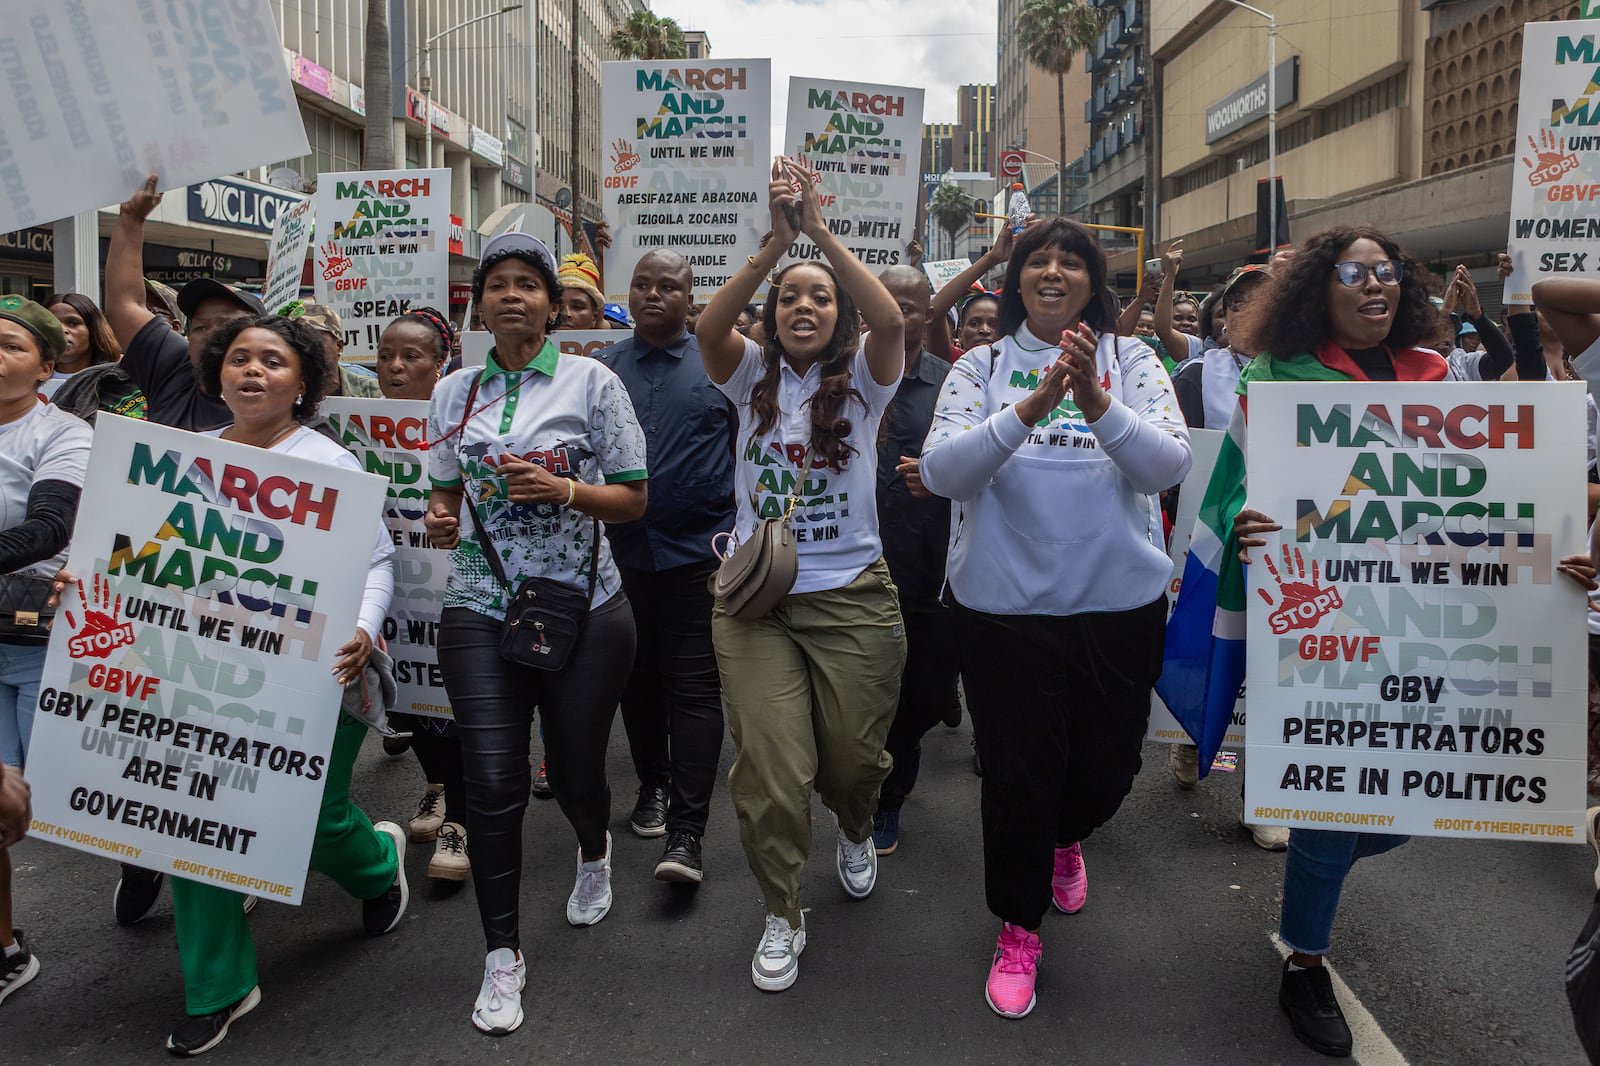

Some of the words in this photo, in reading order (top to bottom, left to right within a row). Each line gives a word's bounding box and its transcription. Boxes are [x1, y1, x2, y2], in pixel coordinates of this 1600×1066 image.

[636, 67, 747, 92] MARCH
[657, 92, 725, 115] AND
[808, 88, 905, 116] MARCH
[1207, 83, 1267, 134] WOOLWORTHS
[636, 115, 747, 140] MARCH
[824, 112, 884, 136] AND
[650, 146, 685, 159] UNTIL
[689, 145, 708, 158] WE
[712, 145, 735, 158] WIN
[804, 132, 901, 160] MARCH
[614, 154, 641, 174] STOP!
[815, 160, 846, 172] UNTIL
[850, 163, 867, 174] WE
[870, 165, 890, 176] WIN
[1530, 155, 1578, 186] STOP!
[336, 178, 431, 200] MARCH
[604, 175, 639, 189] GBVF
[1547, 185, 1600, 202] GBVF
[222, 185, 299, 230] CLICK
[352, 199, 411, 219] AND
[617, 192, 697, 205] ABESIFAZANE
[701, 191, 758, 204] ABAZONA
[819, 194, 837, 208] VF
[333, 217, 429, 240] MARCH
[637, 213, 684, 226] IZIGQILA
[688, 212, 738, 225] ZOCANSI
[858, 221, 901, 239] WITH
[1516, 218, 1600, 239] WOMEN
[345, 245, 376, 256] UNTIL
[379, 244, 394, 255] WE
[398, 243, 418, 254] WIN
[638, 234, 664, 247] IYINI
[668, 233, 737, 246] INKULULEKO
[787, 243, 821, 260] OUR
[324, 259, 352, 280] STOP!
[687, 255, 727, 266] ANDLE
[1538, 252, 1589, 272] SEX
[155, 271, 202, 281] CLICKS
[335, 278, 367, 291] GBVF
[693, 275, 734, 287] BENZI
[353, 299, 411, 318] SPEAK
[1296, 403, 1535, 449] MARCH
[1049, 434, 1068, 447] WE
[1073, 436, 1096, 449] WIN
[127, 442, 339, 531] MARCH
[755, 468, 828, 497] AND
[1340, 452, 1487, 497] AND
[751, 492, 849, 523] ARCH
[155, 500, 284, 564] AND
[487, 526, 517, 541] NTIL
[519, 524, 537, 536] WE
[542, 521, 561, 534] WIN
[812, 525, 839, 542] WIN
[1296, 499, 1535, 547] MARCH
[107, 533, 319, 623] MARCH
[1325, 559, 1400, 584] UNTIL
[1410, 561, 1450, 585] WE
[1461, 562, 1509, 587] WIN
[1271, 590, 1341, 633] STOP!
[124, 596, 190, 632] UNTIL
[198, 619, 231, 643] WE
[240, 626, 285, 656] WIN
[70, 626, 133, 658] STOP!
[1298, 634, 1381, 663] GBVF
[87, 664, 161, 701] GBVF
[1380, 674, 1445, 704] GBV
[38, 687, 95, 723] GBV
[101, 703, 326, 782] PERPETRATORS
[1282, 717, 1546, 756] PERPETRATORS
[121, 755, 182, 791] ARE
[189, 771, 219, 802] IN
[1280, 763, 1347, 792] ARE
[1358, 766, 1389, 796] IN
[1402, 770, 1548, 804] POLITICS
[70, 786, 257, 855] GOVERNMENT
[1254, 806, 1396, 827] #DOIT4YOURCOUNTRY
[1433, 818, 1575, 838] #DOIT4THEIRFUTURE
[29, 820, 142, 859] DOIT4YOURCOUNTRY
[173, 859, 294, 897] #DOIT4THEIRFUTURE
